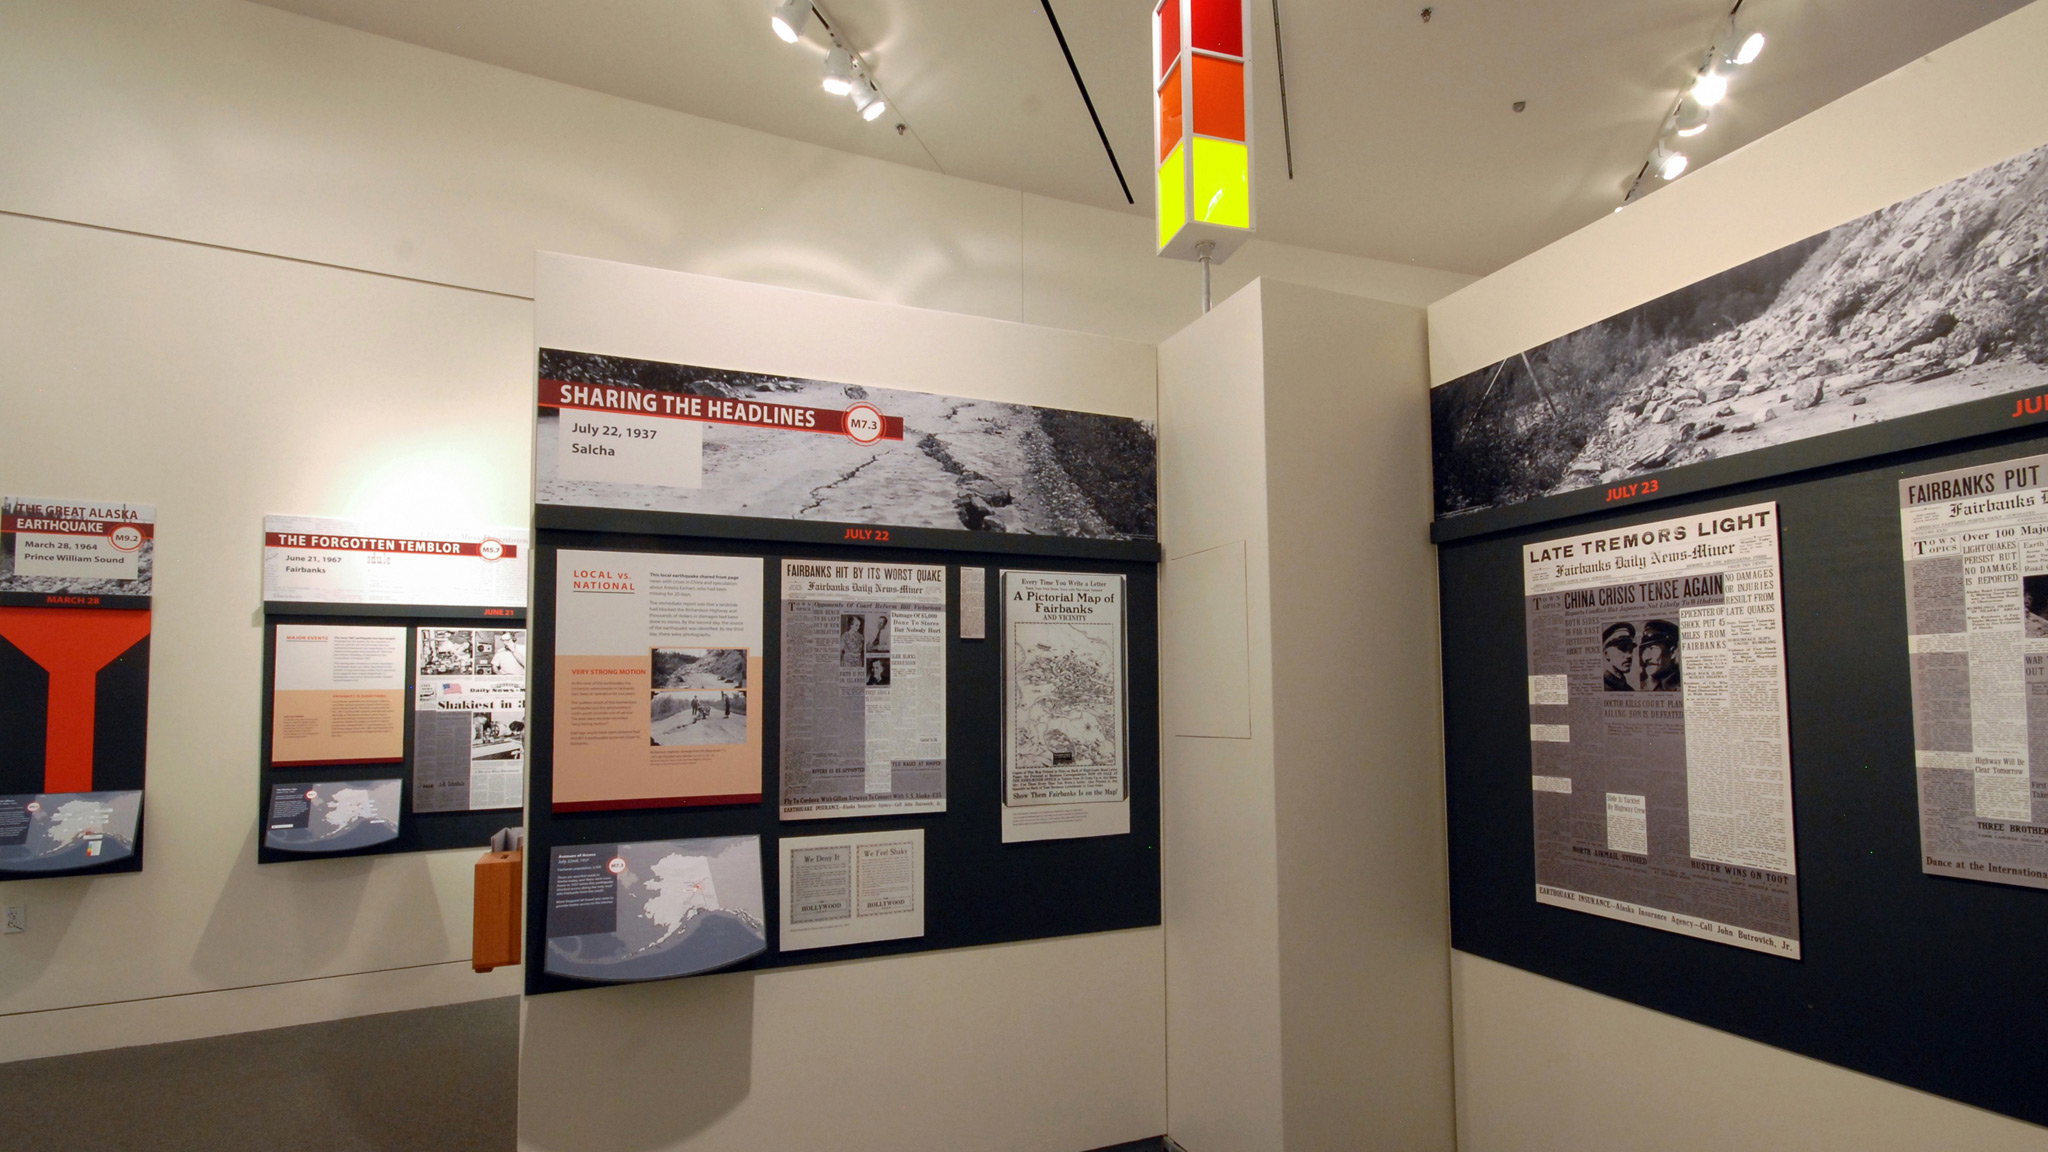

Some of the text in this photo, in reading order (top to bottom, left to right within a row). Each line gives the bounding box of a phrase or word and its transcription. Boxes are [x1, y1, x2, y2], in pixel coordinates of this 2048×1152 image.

[560, 384, 816, 428] SHARING THE HEADLINES
[850, 418, 878, 430] M7.3
[571, 422, 657, 440] July 22, 1937
[572, 443, 616, 457] Salcha
[1908, 464, 2040, 504] FAIRBANKS PUT
[1606, 480, 1660, 502] JULY 23
[18, 503, 138, 520] THE GREAT ALASKA
[1949, 494, 2035, 518] Fairbanks
[16, 518, 104, 533] EARTHQUAKE
[115, 534, 138, 542] M9.2
[844, 528, 890, 541] JULY 22
[1529, 511, 1771, 563] LATE TREMORS LIGHT
[1962, 528, 2015, 542] Over 100
[24, 541, 55, 550] March
[57, 542, 72, 550] 28,
[278, 534, 461, 554] THE FORGOTTEN TEMBLOR
[482, 546, 500, 554] M5.7
[1963, 540, 2017, 554] LIGHT QUAKES
[24, 553, 125, 564] Prince William Sound
[285, 554, 342, 564] June 21, 1967
[1554, 542, 1736, 578] Fairbanks Daily News-Miner
[1964, 552, 2018, 564] PERSIST BUT
[285, 566, 326, 574] Fairbanks
[573, 570, 613, 579] LOCAL
[786, 564, 942, 583] FAIRBANKS HIT BY ITS WORST QUAKE
[1964, 562, 2018, 575] NO DAMAGE
[1724, 568, 1774, 582] NO DAMAGES
[1965, 574, 2018, 586] IS REPORTED
[573, 581, 636, 591] NATIONAL
[808, 581, 924, 594] Fairbanks Daily News-Miner
[1021, 578, 1038, 586] Every
[1725, 580, 1774, 594] OR INJURIES
[1014, 591, 1115, 605] A Pictorial Map of
[1564, 574, 1724, 610] CHINA CRISIS TENSE AGAIN
[46, 596, 100, 605] MARCH 28
[1726, 592, 1774, 605] RESULT FROM
[483, 608, 503, 616] JUNE
[1035, 603, 1094, 614] Fairbanks
[1680, 607, 1725, 619] EPICENTER OF
[1726, 604, 1775, 616] LATE QUAKES
[1680, 620, 1701, 630] SHOCK
[1702, 619, 1716, 628] PUT
[1681, 629, 1726, 640] MILES FROM
[1681, 640, 1727, 651] FAIRBANKS
[437, 700, 512, 710] Shakiest in
[1048, 790, 1077, 798] Fairbanks
[890, 848, 908, 856] Shaky
[1926, 856, 1984, 872] Dance at the
[1691, 860, 1789, 885] BUSTER WINS ON TOOT
[801, 902, 842, 912] HOLLYWOOD
[867, 899, 905, 908] HOLLYWOOD
[1539, 887, 1576, 901] EARTHQUAKE
[1638, 907, 1667, 921] Insurance
[1717, 925, 1734, 938] John
[1738, 930, 1777, 948] Butrovich,
[1781, 940, 1793, 952] Jr.
